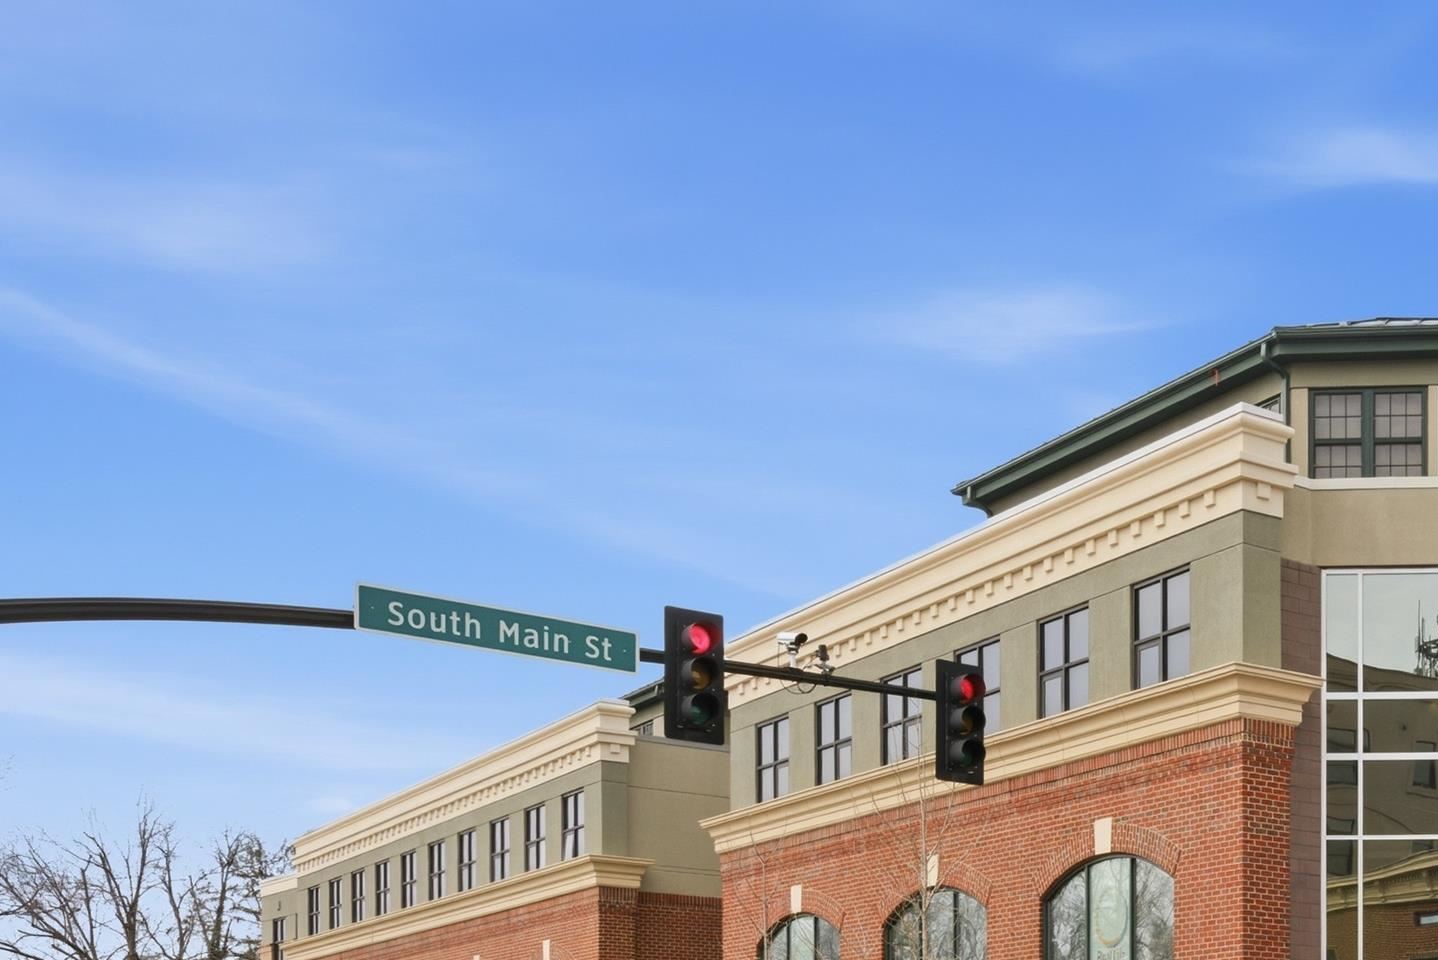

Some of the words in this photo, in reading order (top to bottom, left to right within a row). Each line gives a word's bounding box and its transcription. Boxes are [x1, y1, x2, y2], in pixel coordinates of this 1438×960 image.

[387, 601, 481, 639] South
[499, 619, 569, 654] Main
[584, 635, 613, 661] St
